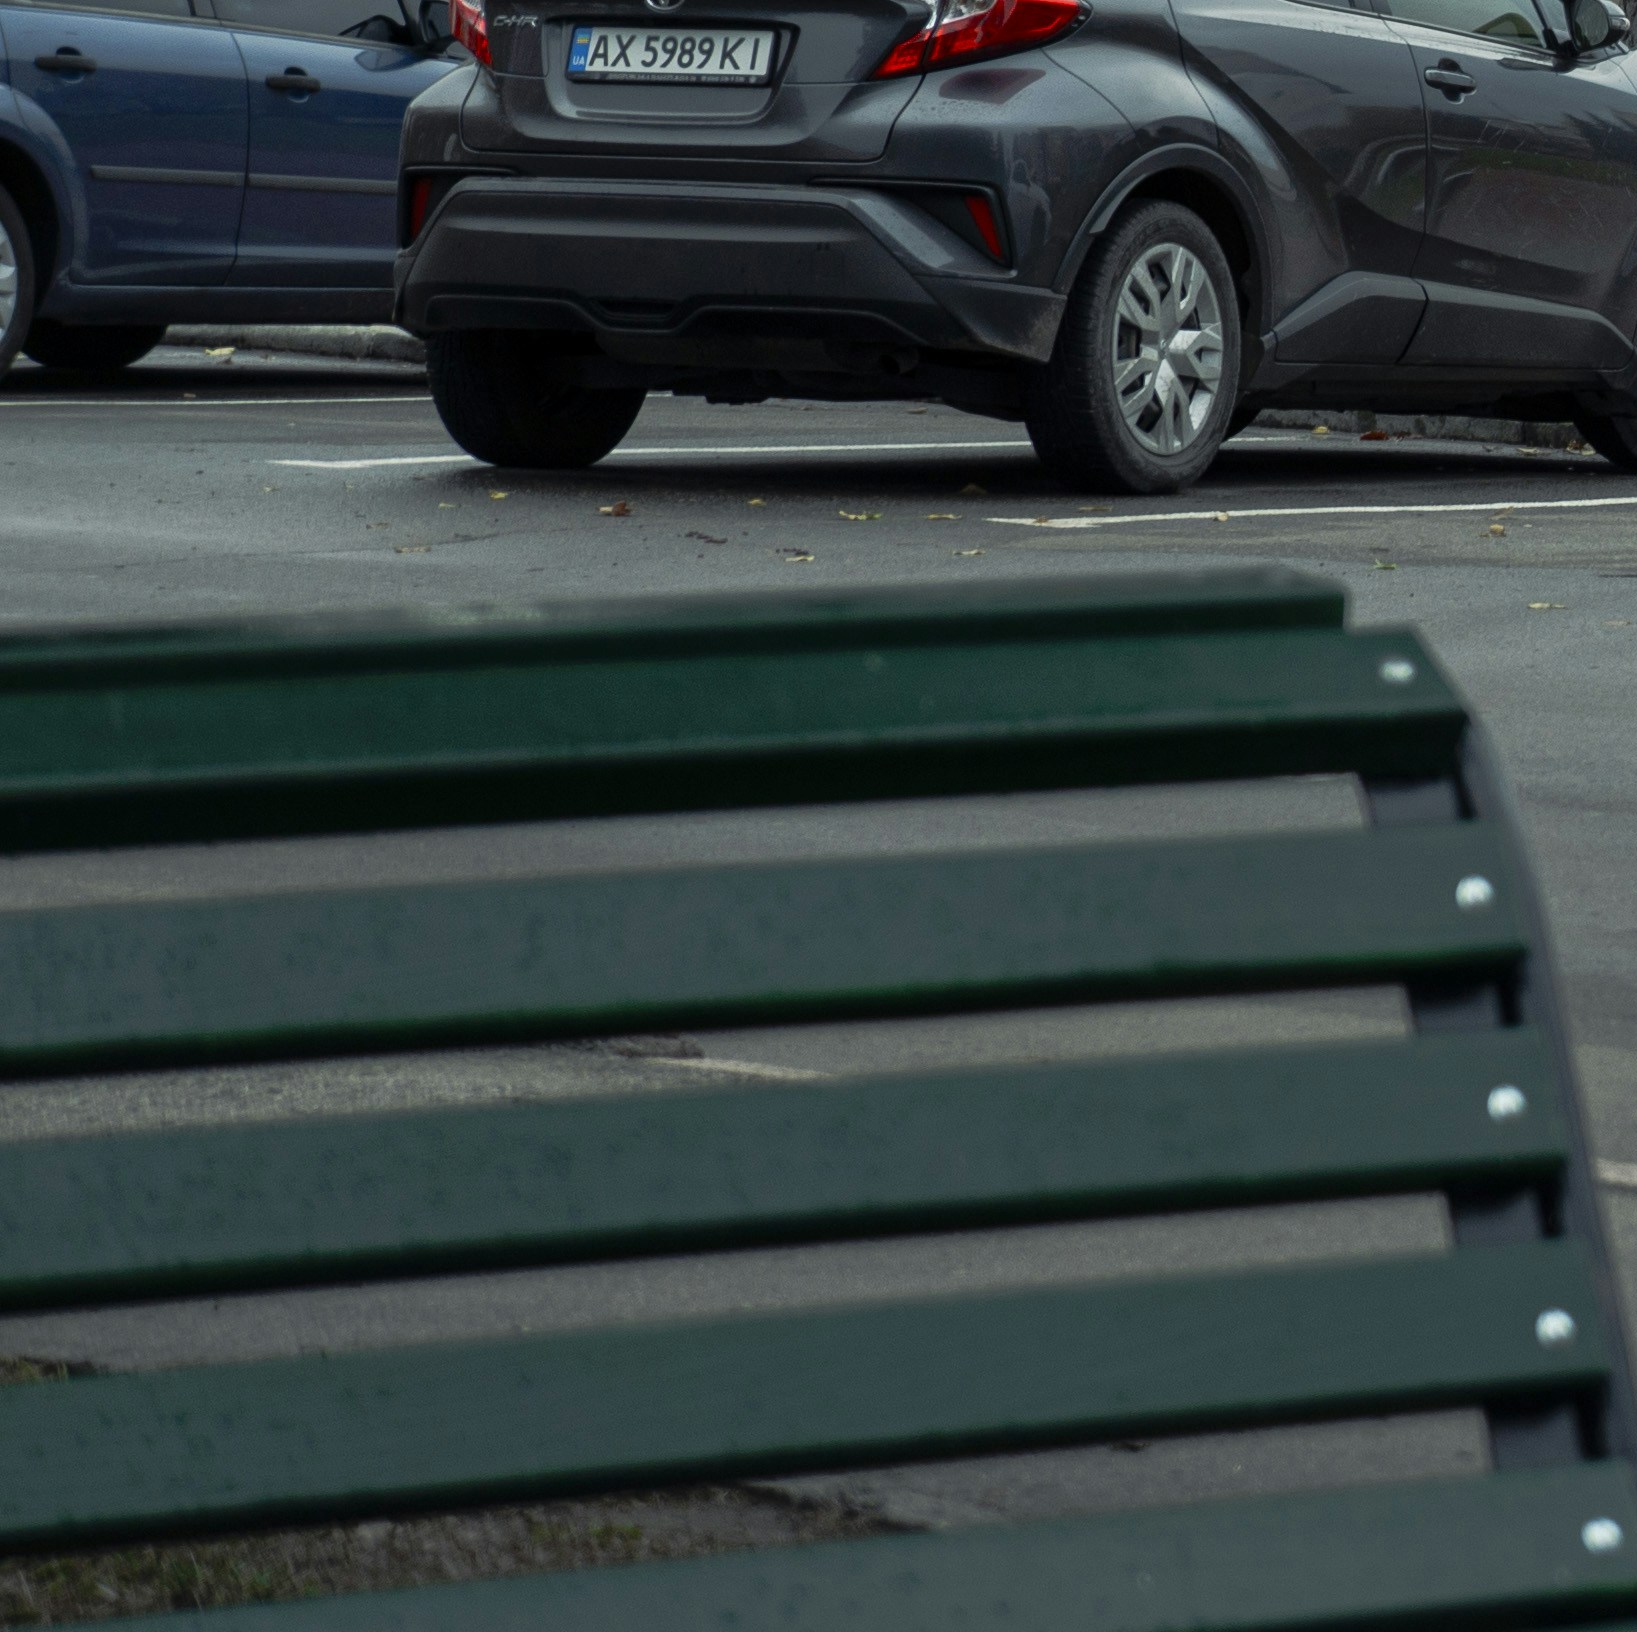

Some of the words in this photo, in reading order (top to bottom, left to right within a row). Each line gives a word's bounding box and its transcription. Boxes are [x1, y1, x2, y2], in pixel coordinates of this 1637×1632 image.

[572, 55, 586, 66] UA
[588, 34, 636, 68] AX
[640, 35, 715, 70] 5989
[719, 36, 760, 71] KI
